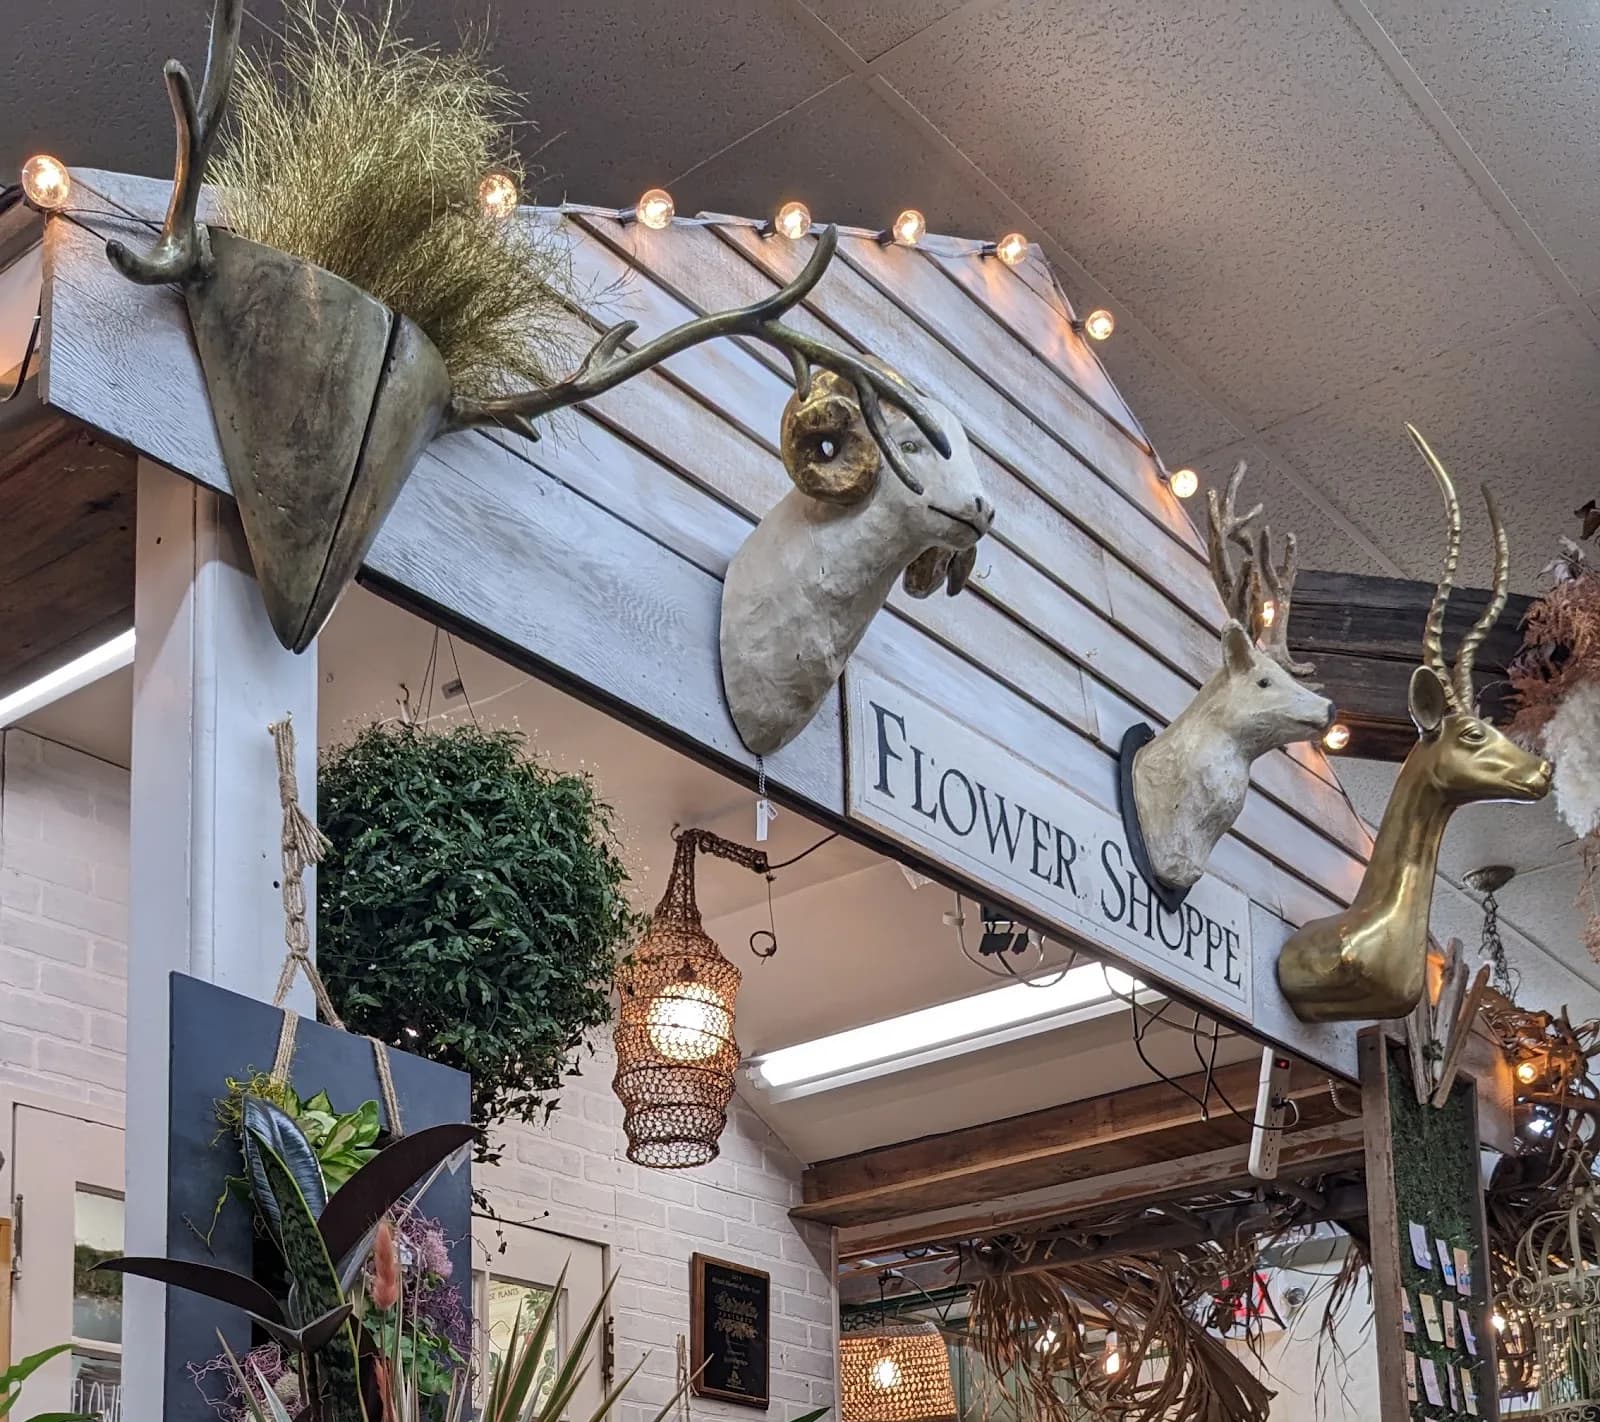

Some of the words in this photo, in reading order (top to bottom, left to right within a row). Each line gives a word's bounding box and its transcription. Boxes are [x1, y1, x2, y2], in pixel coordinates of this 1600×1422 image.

[869, 700, 1083, 900] FLOWER
[1100, 839, 1243, 990] SHOPPE
[498, 1287, 519, 1299] PLANTS
